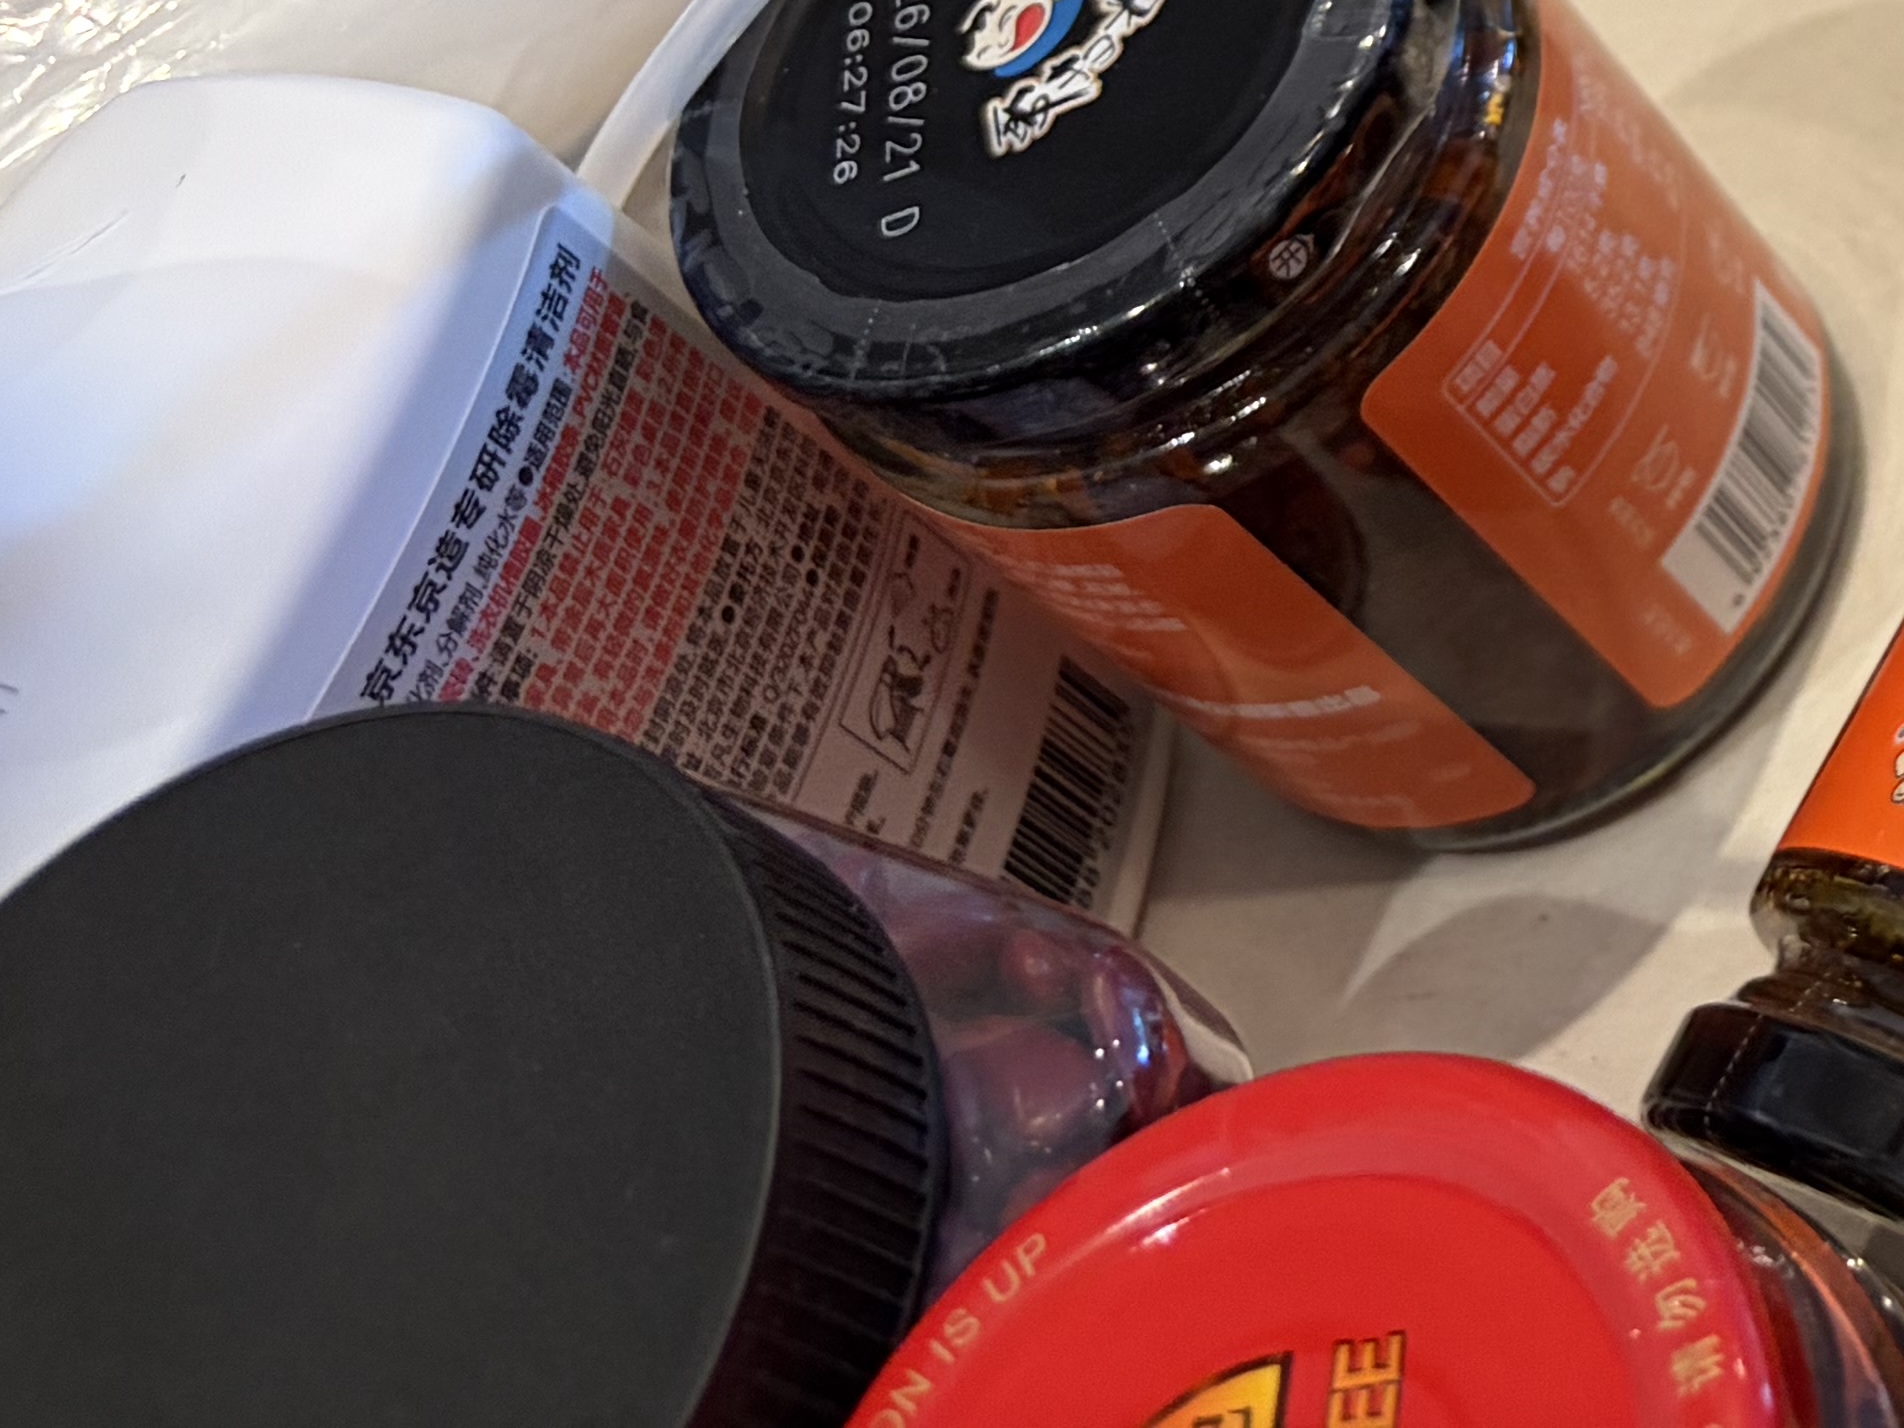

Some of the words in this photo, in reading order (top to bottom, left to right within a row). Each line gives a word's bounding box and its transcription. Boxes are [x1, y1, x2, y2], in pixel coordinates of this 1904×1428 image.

[879, 202, 921, 241] D
[356, 242, 581, 710] 京东京造专研除霉清洁剂
[928, 1307, 982, 1365] IS
[983, 1232, 1050, 1305] UP
[1588, 1175, 1730, 1399] 请勿选购
